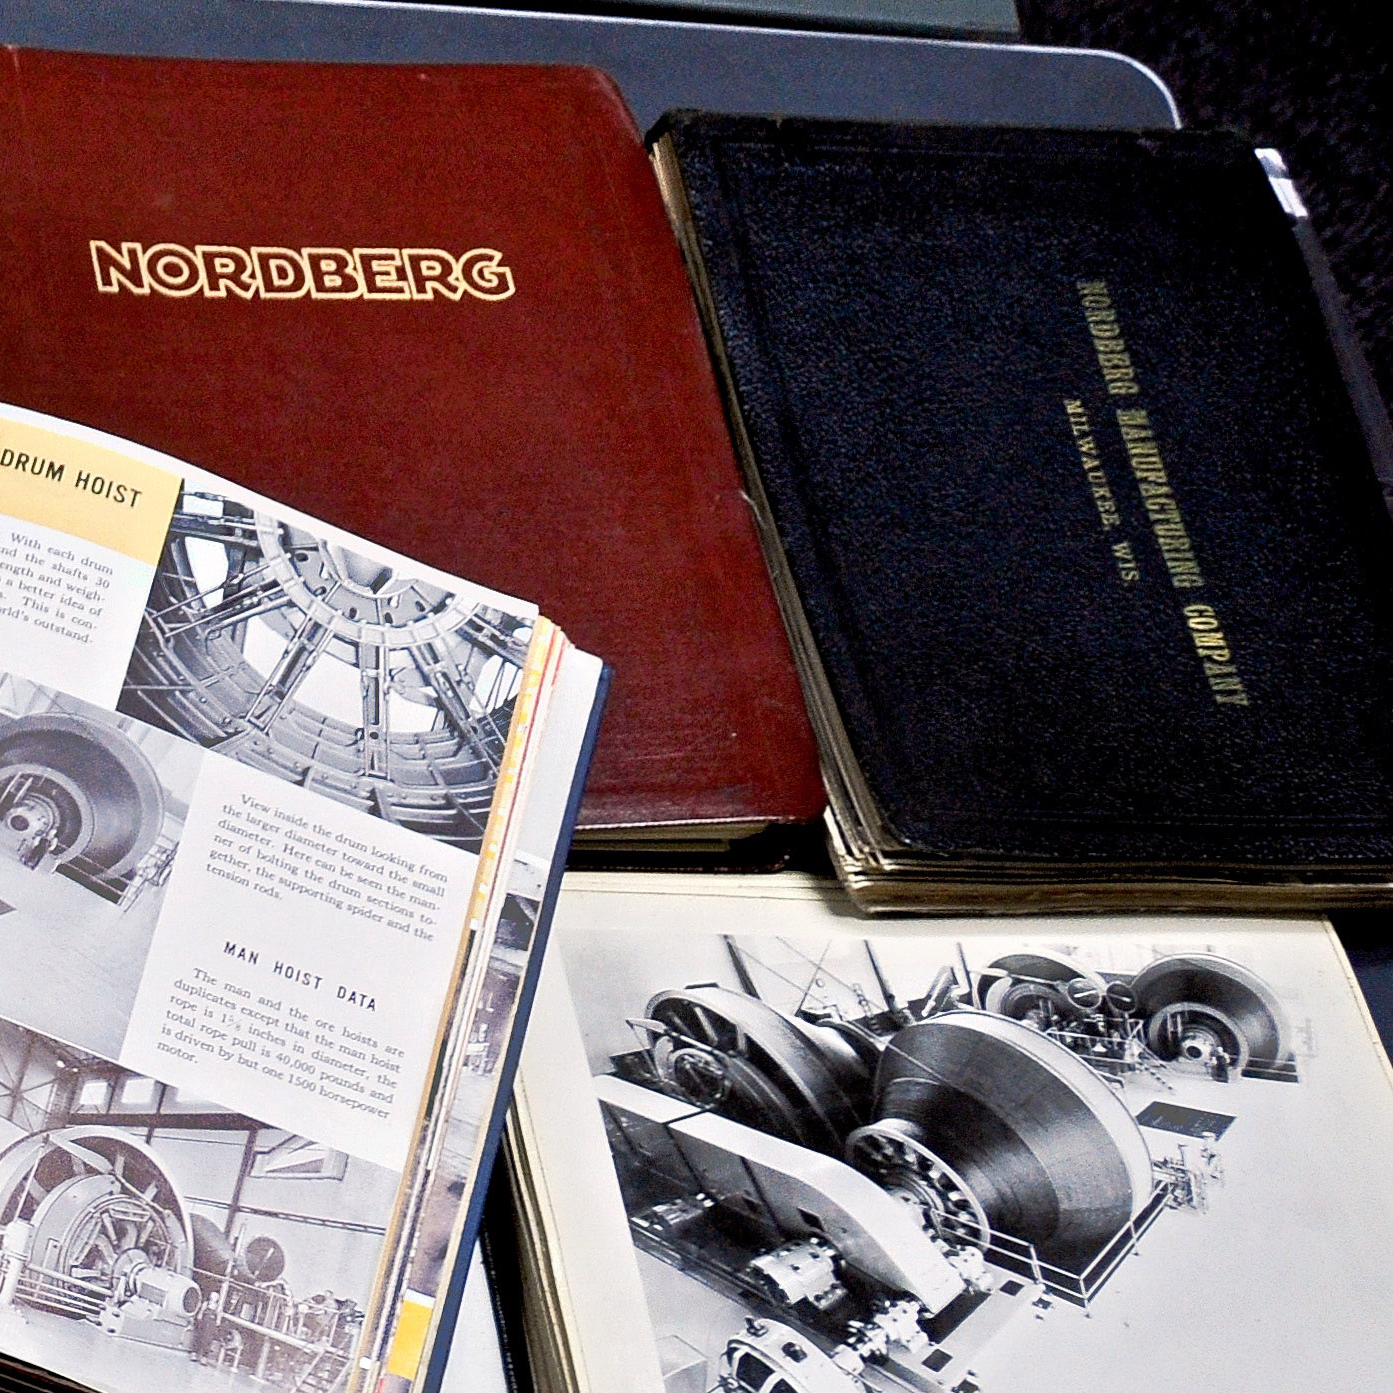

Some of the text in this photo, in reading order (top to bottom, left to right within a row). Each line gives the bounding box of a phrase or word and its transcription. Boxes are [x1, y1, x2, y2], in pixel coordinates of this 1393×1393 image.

[90, 240, 515, 301] NORDBERG
[0, 448, 65, 482] DRUM
[75, 470, 142, 508] HOIST
[1076, 281, 1248, 706] NORDBERG MANUFACTURING COMPANY
[25, 553, 45, 566] the
[51, 562, 88, 581] shafts
[95, 577, 110, 589] 30
[241, 794, 448, 883] View inside the drum looking from
[223, 941, 375, 1011] MAN HOIST DATA
